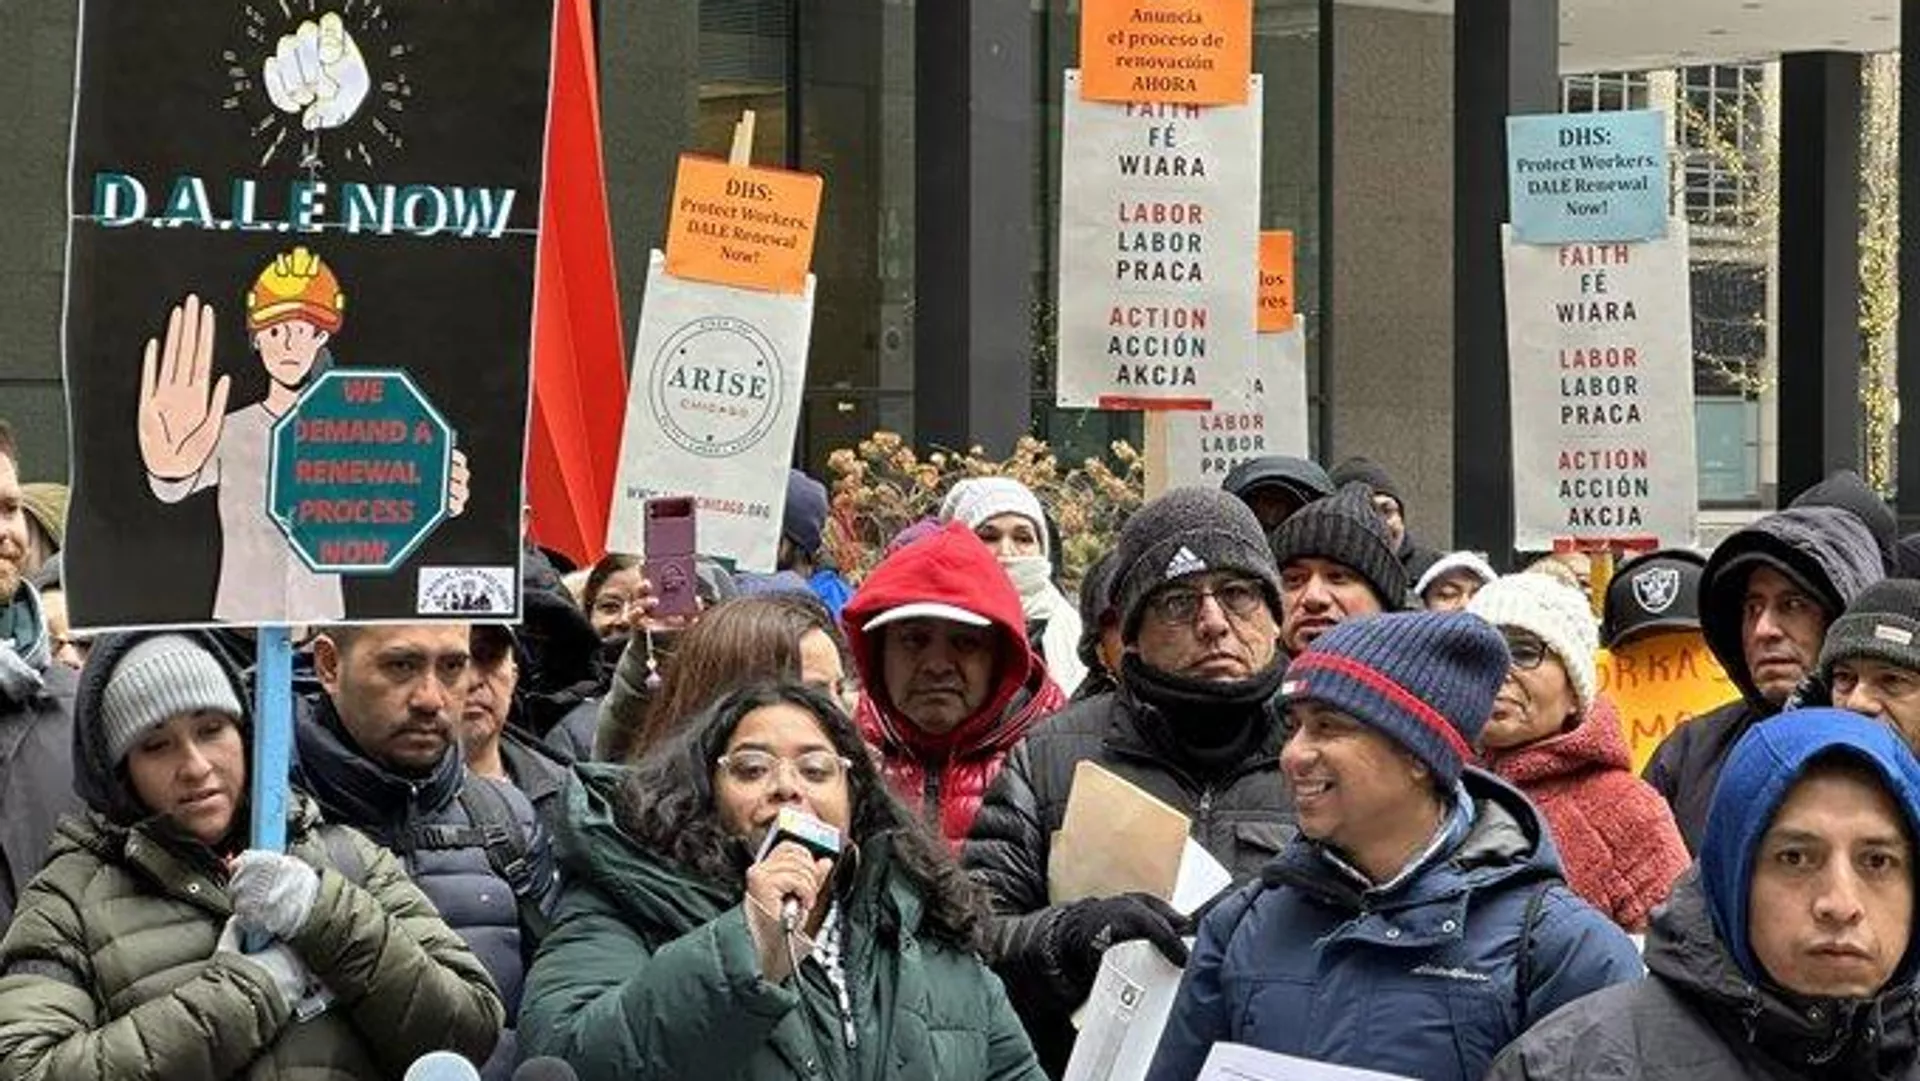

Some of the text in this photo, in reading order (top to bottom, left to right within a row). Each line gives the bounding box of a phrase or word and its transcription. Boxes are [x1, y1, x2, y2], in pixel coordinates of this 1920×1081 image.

[1130, 8, 1203, 25] Anuncia
[1107, 30, 1225, 49] el proceso de
[1115, 54, 1214, 70] renovación
[1131, 76, 1198, 92] AHORA
[1126, 101, 1200, 119] FAITH
[1149, 123, 1176, 148] FÉ
[1558, 127, 1612, 147] DHS:
[1119, 155, 1205, 176] WIARA
[1517, 153, 1658, 173] Protect Workers.
[725, 178, 774, 202] DHS:
[1527, 175, 1648, 194] DALE Renewal
[341, 182, 516, 239] NOW
[681, 197, 738, 221] Protect
[1119, 203, 1202, 224] LABOR
[1566, 200, 1608, 216] Now!
[687, 219, 797, 250] DALE Renewal
[1118, 232, 1202, 251] LABOR
[719, 245, 761, 264] Now!
[1559, 246, 1628, 266] FAITH
[1117, 261, 1202, 282] PRACA
[1109, 307, 1206, 328] ACTION
[1557, 303, 1636, 323] WIARA
[1108, 334, 1205, 356] ACCIÓN
[1560, 349, 1637, 369] LABOR
[668, 365, 766, 400] ARISE
[1116, 365, 1197, 386] AKCJA
[343, 379, 384, 402] WE
[1561, 376, 1638, 396] LABOR
[1201, 414, 1264, 431] LABOR
[1561, 404, 1641, 425] PRACA
[414, 421, 431, 444] A
[1202, 435, 1264, 453] LABOR
[1559, 450, 1647, 470] ACTION
[296, 459, 421, 485] RENEWAL
[1559, 475, 1648, 498] ACCIÓN
[298, 500, 413, 524] PROCESS
[1568, 507, 1642, 526] AKCJA
[320, 541, 388, 563] NOW
